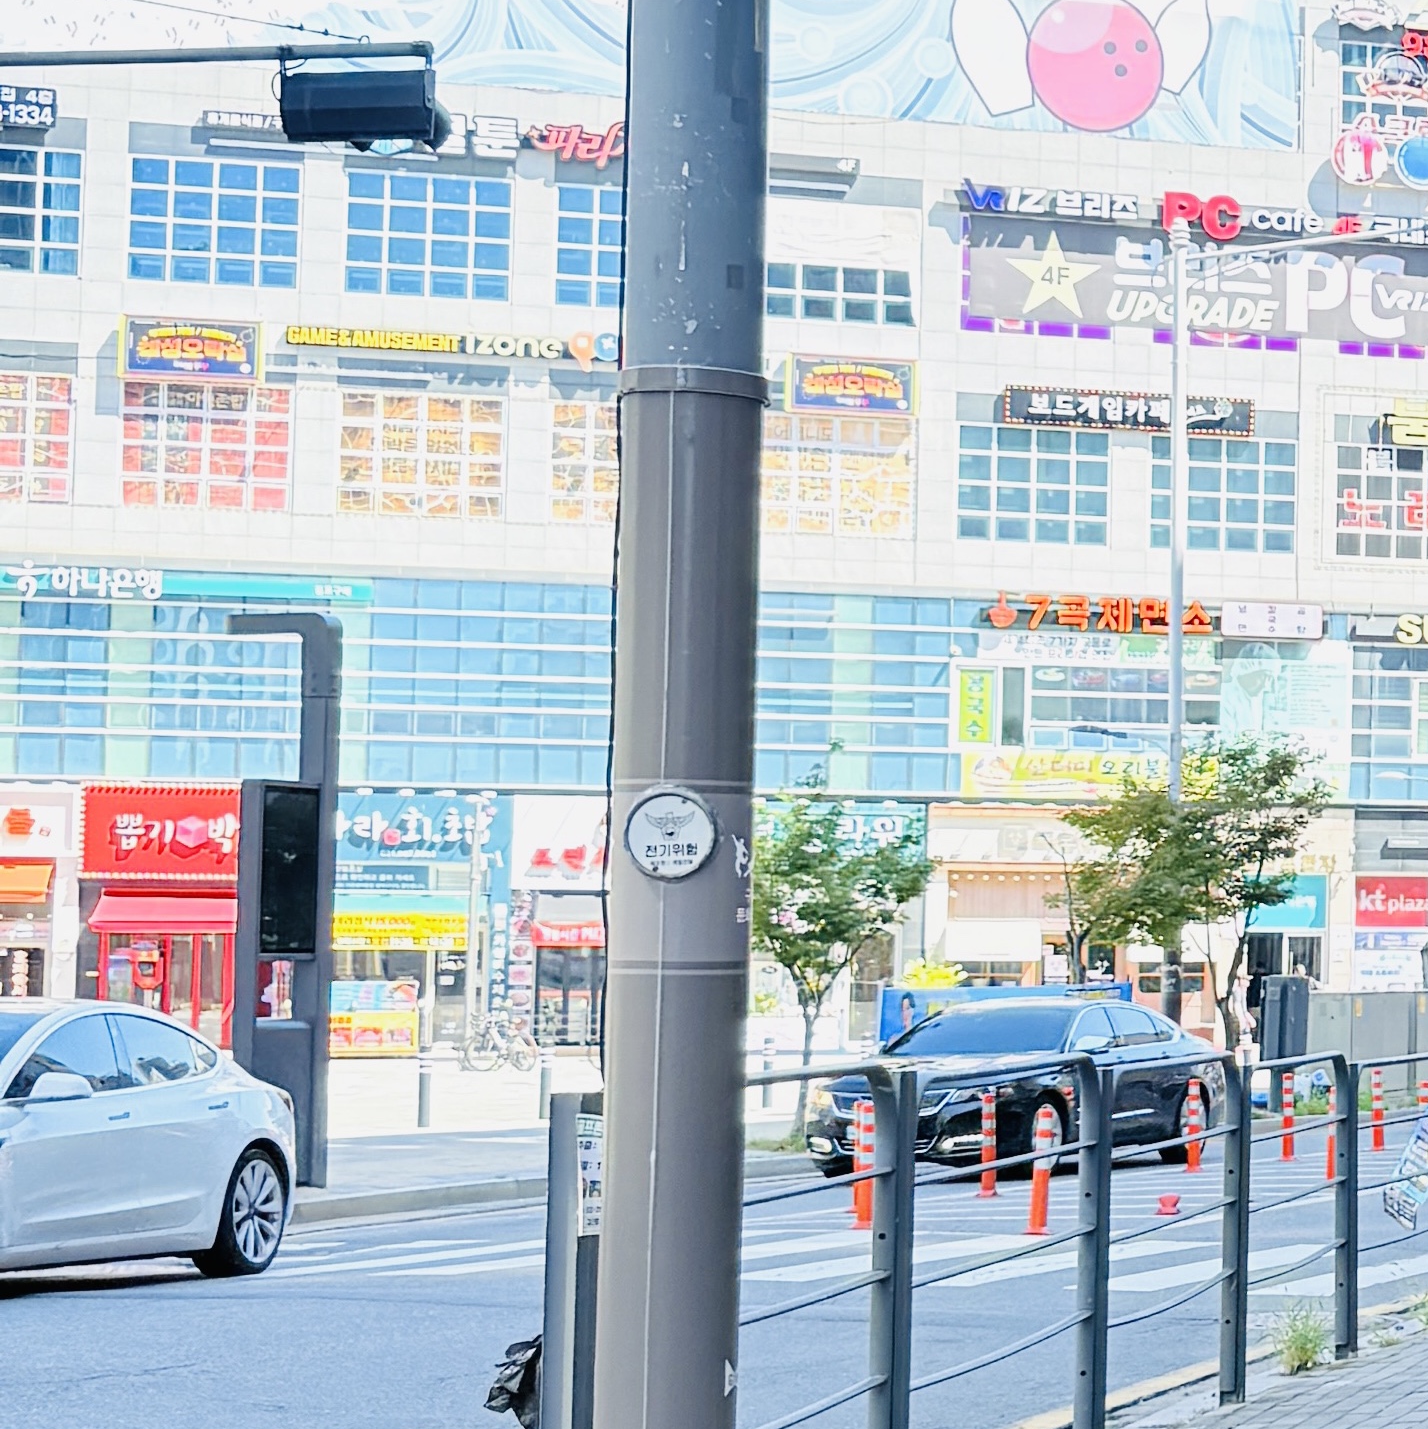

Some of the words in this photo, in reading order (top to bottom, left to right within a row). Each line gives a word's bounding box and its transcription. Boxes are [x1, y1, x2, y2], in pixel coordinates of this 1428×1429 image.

[1055, 190, 1139, 221] 브리즈
[1162, 190, 1244, 241] PC
[1251, 207, 1325, 234] cafe
[1040, 264, 1071, 285] 4F
[1285, 251, 1407, 339] PC
[51, 565, 164, 600] 하나은행
[1024, 593, 1214, 635] 7곡제면소
[114, 813, 175, 851] 뽑기
[207, 812, 240, 854] 박
[1359, 883, 1388, 912] kt
